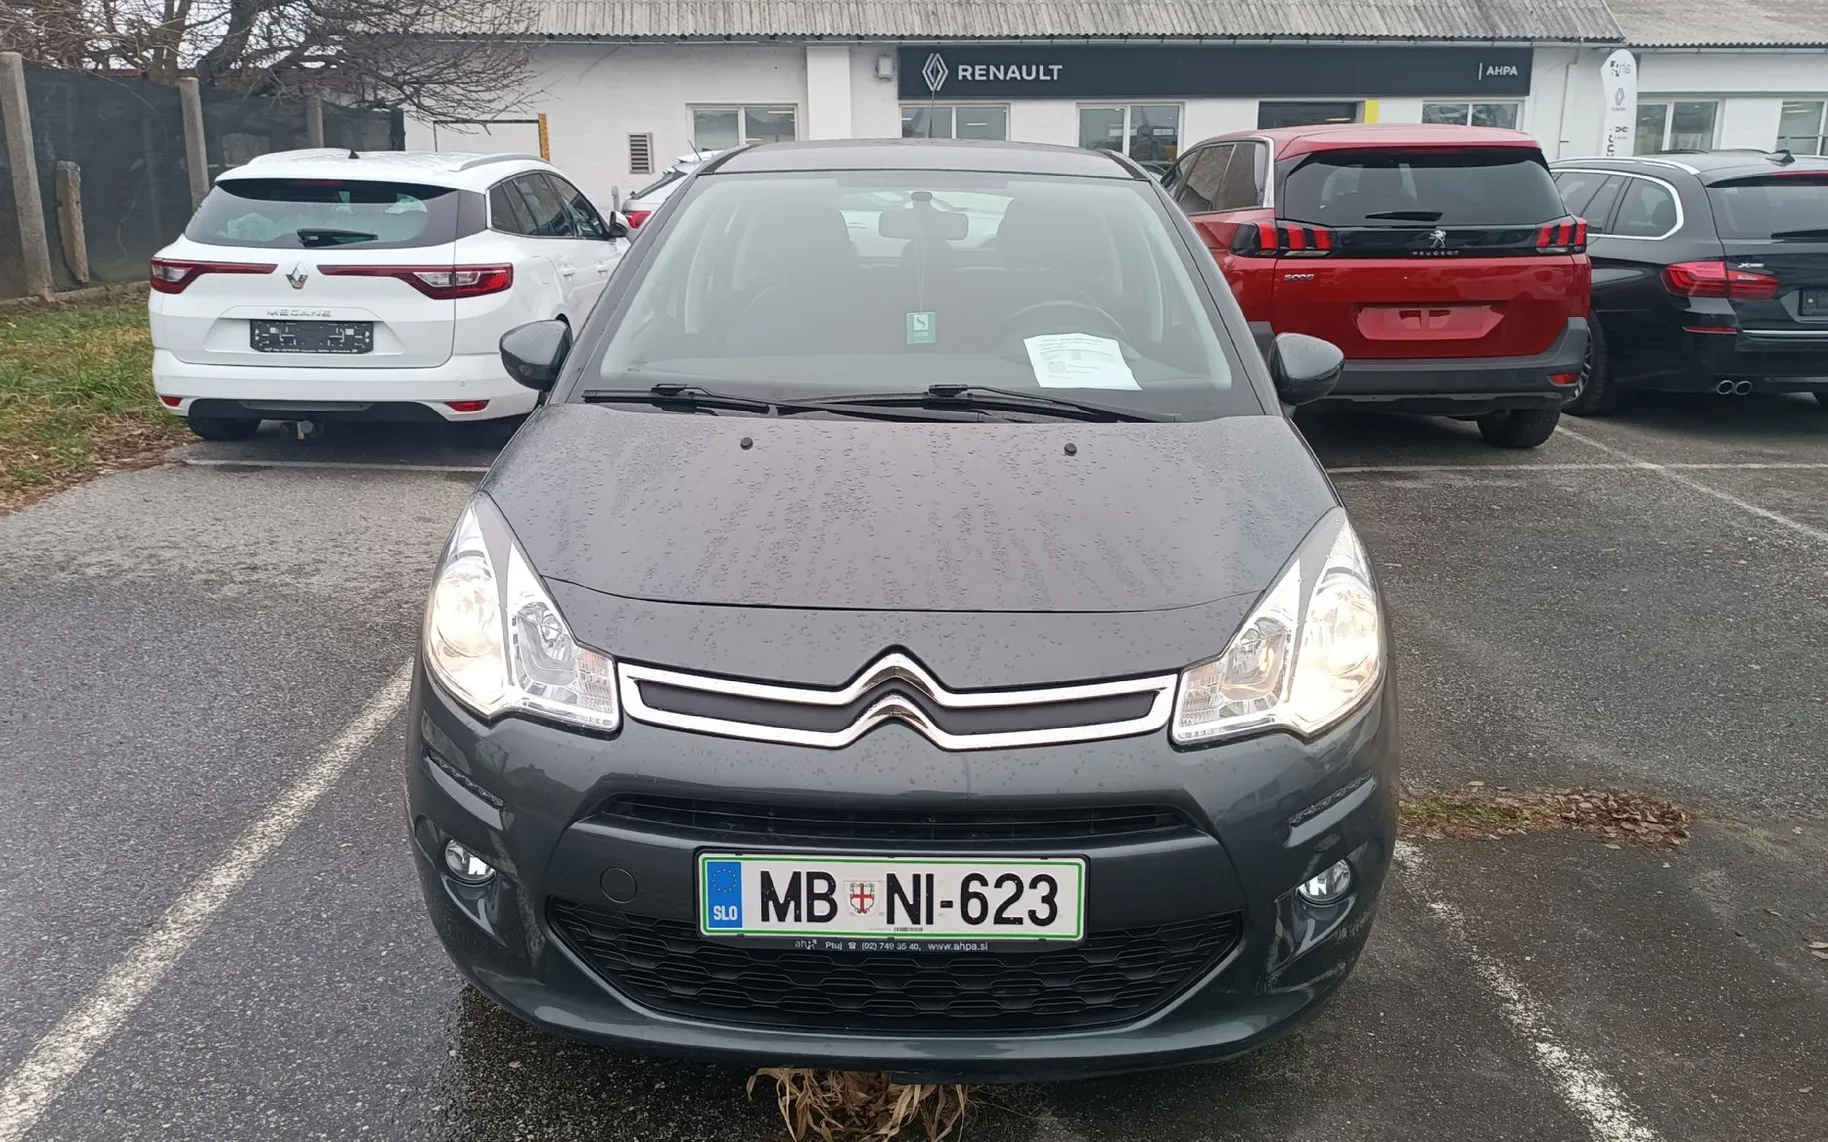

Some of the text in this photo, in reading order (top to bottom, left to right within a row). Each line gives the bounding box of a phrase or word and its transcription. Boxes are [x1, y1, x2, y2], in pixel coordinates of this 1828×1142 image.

[958, 65, 1063, 81] RENAULT
[1486, 65, 1518, 75] AHPA
[760, 870, 1059, 926] MB NI-623
[713, 905, 738, 921] SLO
[825, 941, 842, 951] Ptuj
[861, 941, 877, 951] (02)
[879, 942, 895, 950] 749
[896, 942, 907, 950] 35
[927, 941, 988, 951] www.ahpa.si
